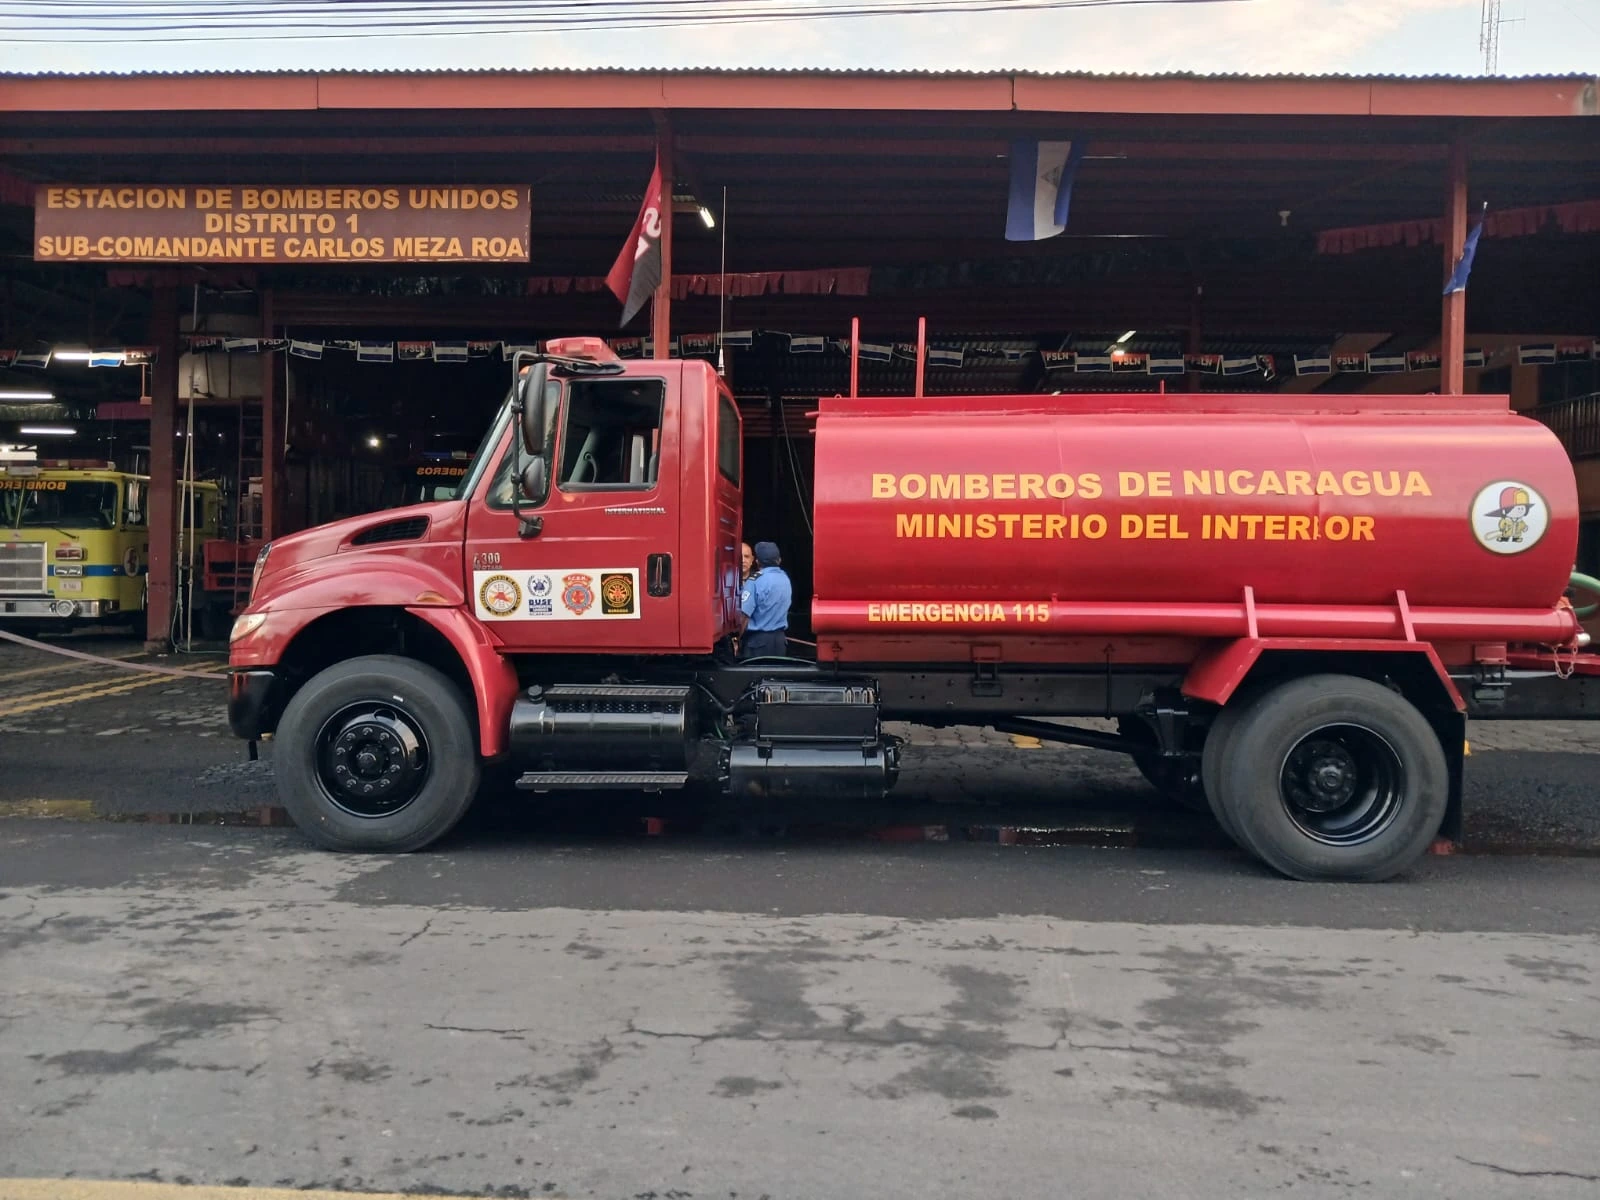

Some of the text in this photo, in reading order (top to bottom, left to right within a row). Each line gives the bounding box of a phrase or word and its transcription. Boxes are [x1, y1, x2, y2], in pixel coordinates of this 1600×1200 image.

[47, 189, 518, 209] ESTACION DE BOMBEROS UNIDOS
[205, 213, 358, 233] DISTRITO 1
[39, 236, 524, 258] SUB-COMANDANTE CARLOS MEZA ROA
[871, 470, 1432, 500] BOMBEROS DE NICARAGUA
[895, 513, 1376, 541] MINISTERIO DEL INTERIOR
[868, 604, 1049, 622] EMERGENCIA 115
